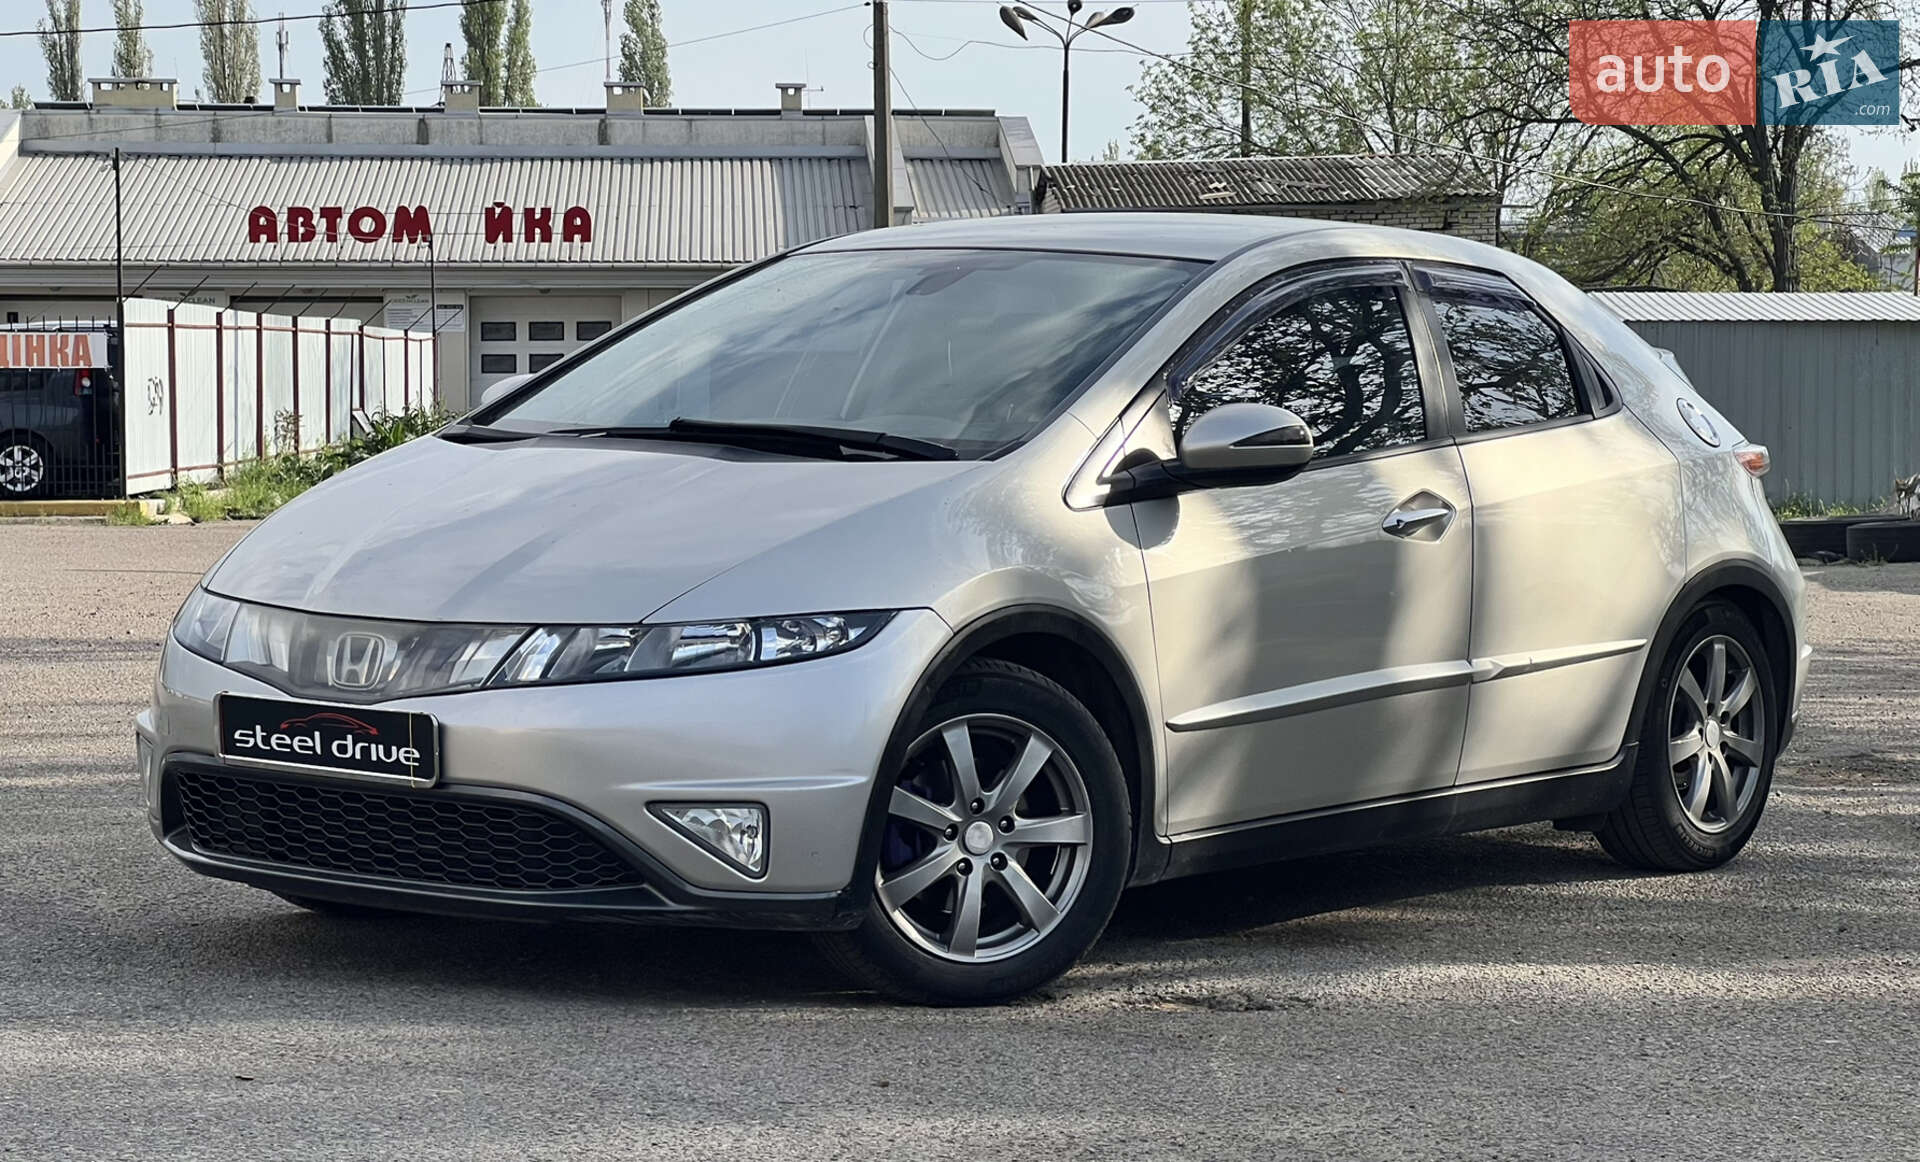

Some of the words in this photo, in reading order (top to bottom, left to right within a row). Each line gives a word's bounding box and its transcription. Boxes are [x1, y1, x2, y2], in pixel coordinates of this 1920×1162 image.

[248, 205, 432, 244] АВТОМ
[484, 202, 592, 244] ЙКА
[233, 724, 322, 755] steel
[331, 734, 421, 766] drive
